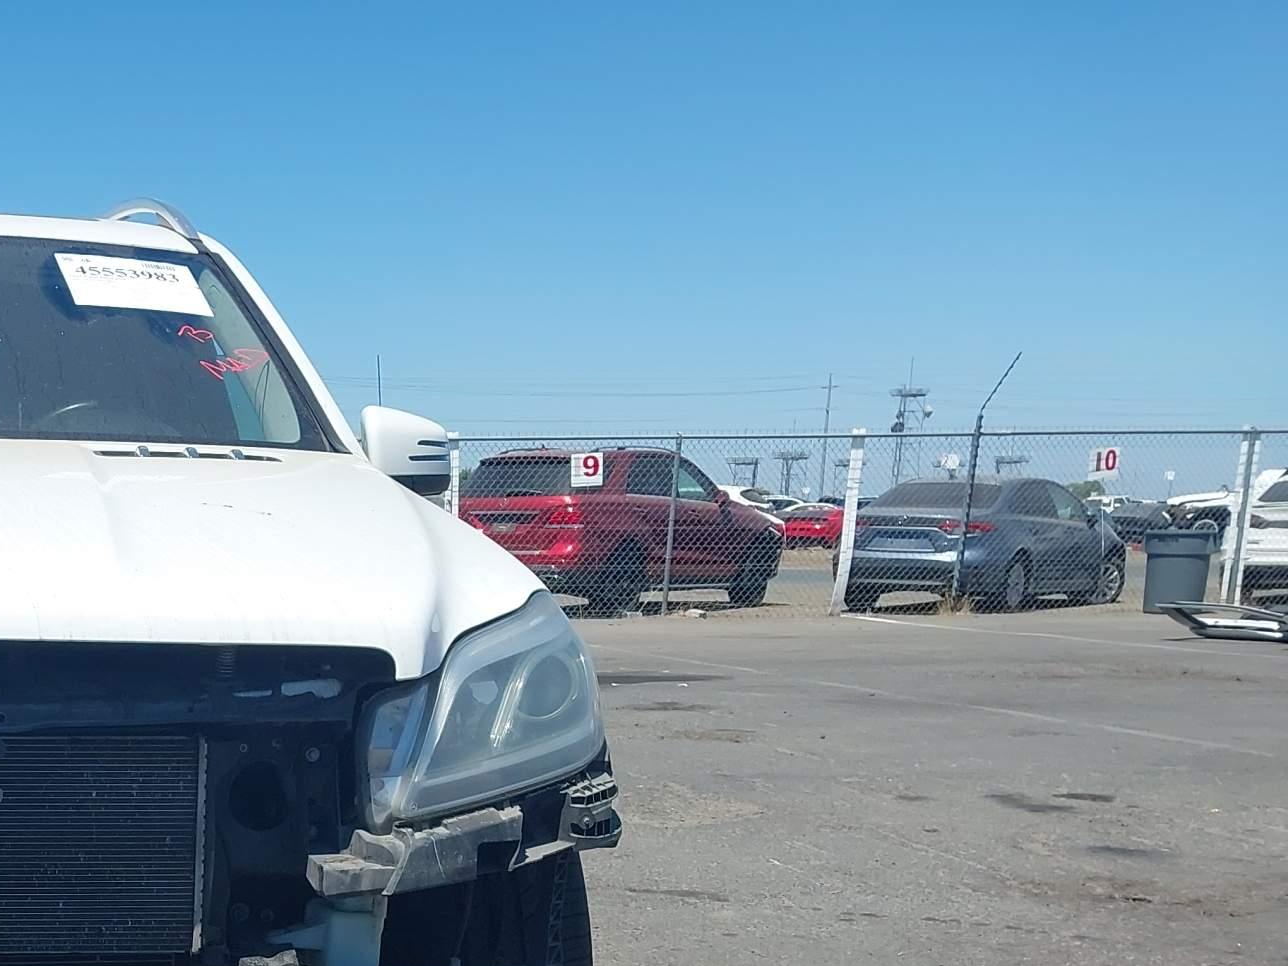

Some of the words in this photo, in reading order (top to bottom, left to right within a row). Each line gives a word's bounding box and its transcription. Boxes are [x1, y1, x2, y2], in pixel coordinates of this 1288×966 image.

[75, 265, 180, 283] 45553983
[582, 455, 600, 477] 9
[1095, 449, 1117, 472] 10
